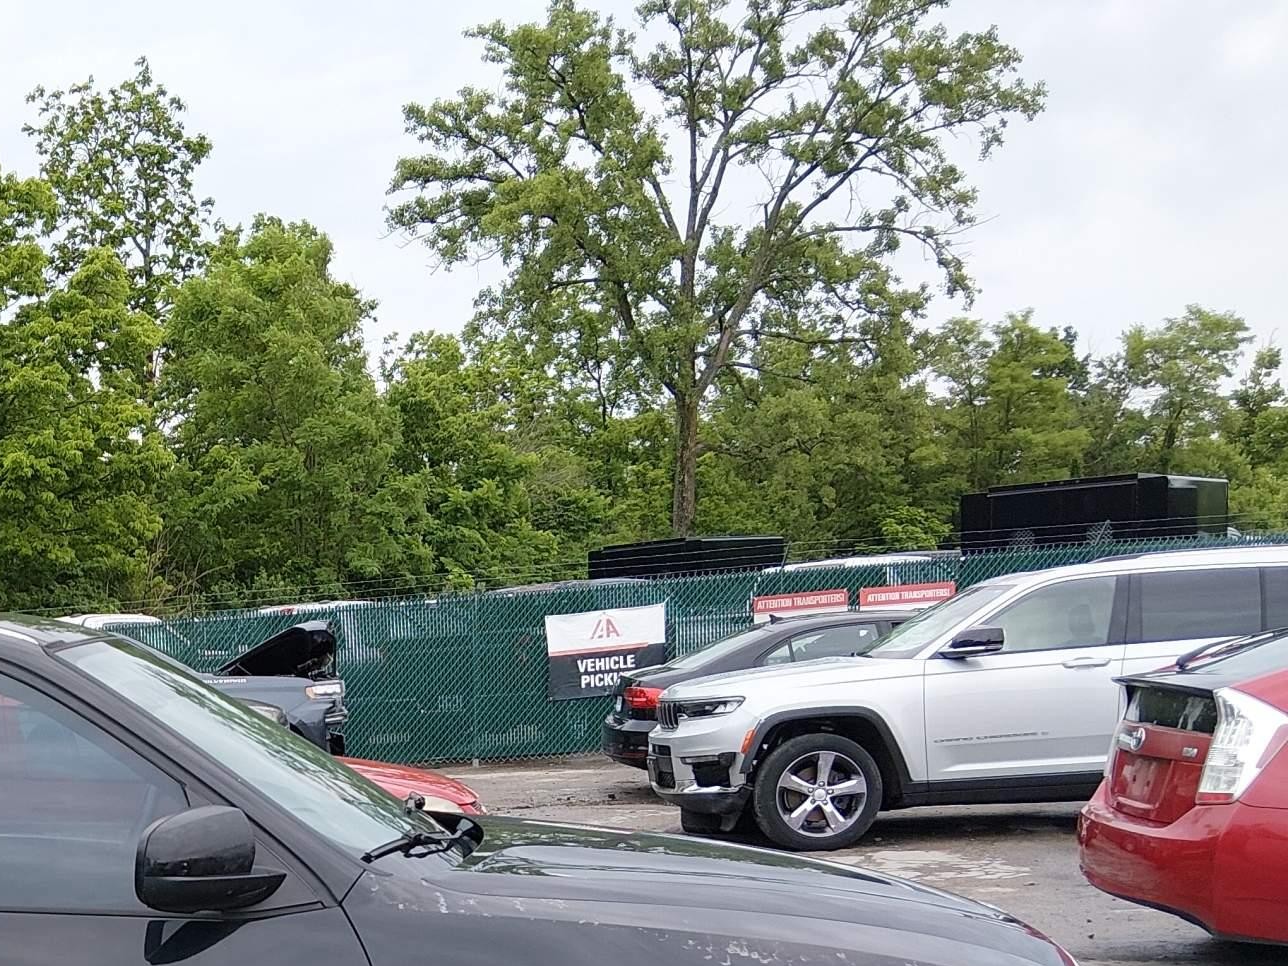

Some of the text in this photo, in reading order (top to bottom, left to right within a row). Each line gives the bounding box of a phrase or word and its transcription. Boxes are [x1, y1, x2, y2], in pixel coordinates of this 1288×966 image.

[756, 593, 845, 610] ATTENTION TRANSPORTERS!
[867, 591, 900, 603] ATTENTION
[576, 654, 636, 673] VEHICLE
